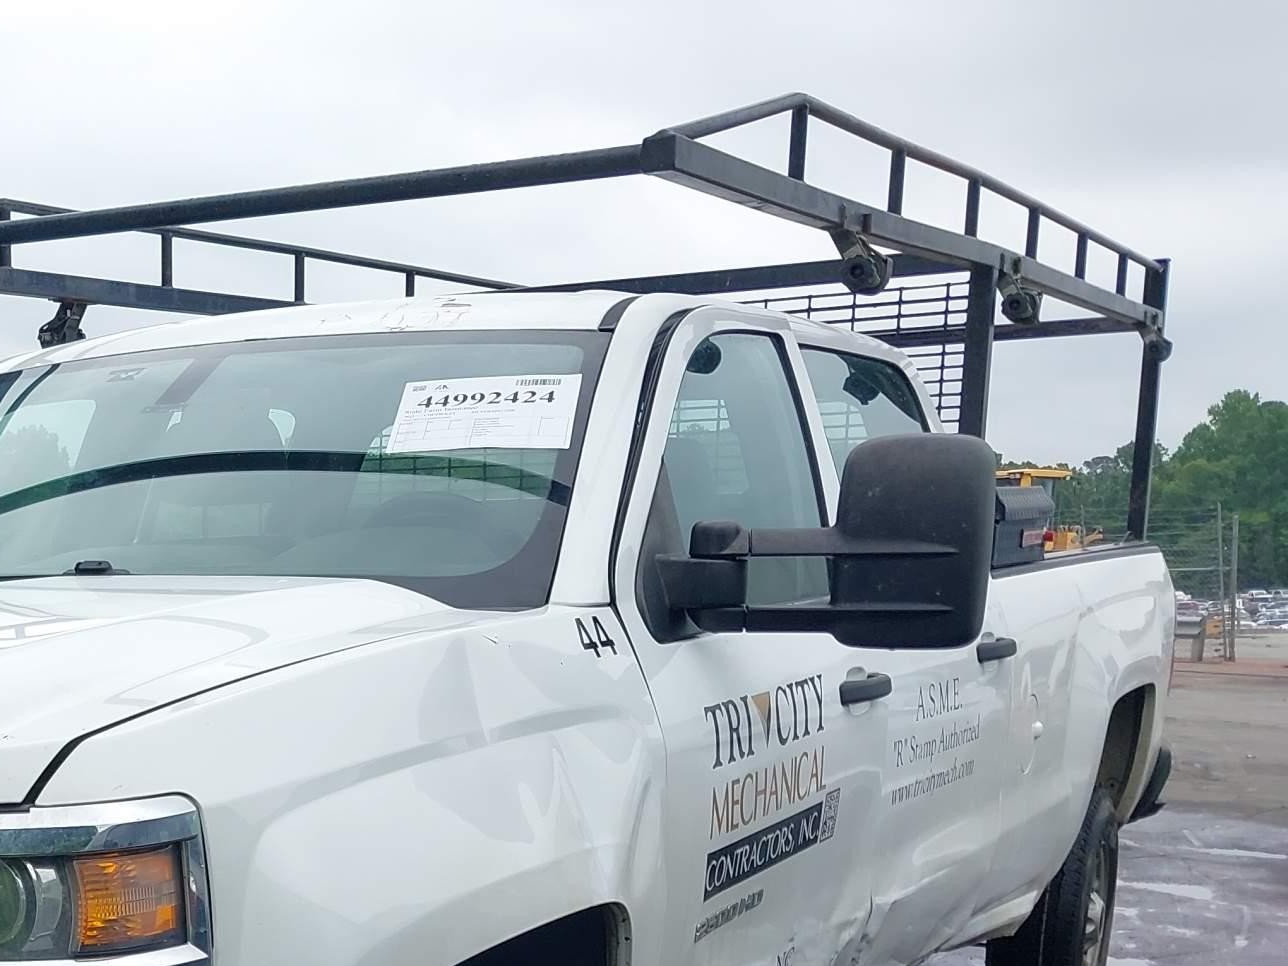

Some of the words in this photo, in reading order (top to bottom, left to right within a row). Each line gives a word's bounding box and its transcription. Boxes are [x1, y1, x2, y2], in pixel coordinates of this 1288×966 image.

[417, 390, 556, 408] 44992424
[575, 616, 617, 658] 44
[703, 694, 755, 769] TRI
[775, 674, 825, 746] CITY
[915, 677, 963, 722] A.S.M.E.
[909, 735, 938, 764] Stamp
[938, 713, 981, 753] Authorized
[710, 745, 826, 840] MECHANICAL
[706, 823, 795, 891] CONTRACTORS,
[798, 812, 820, 845] INC.
